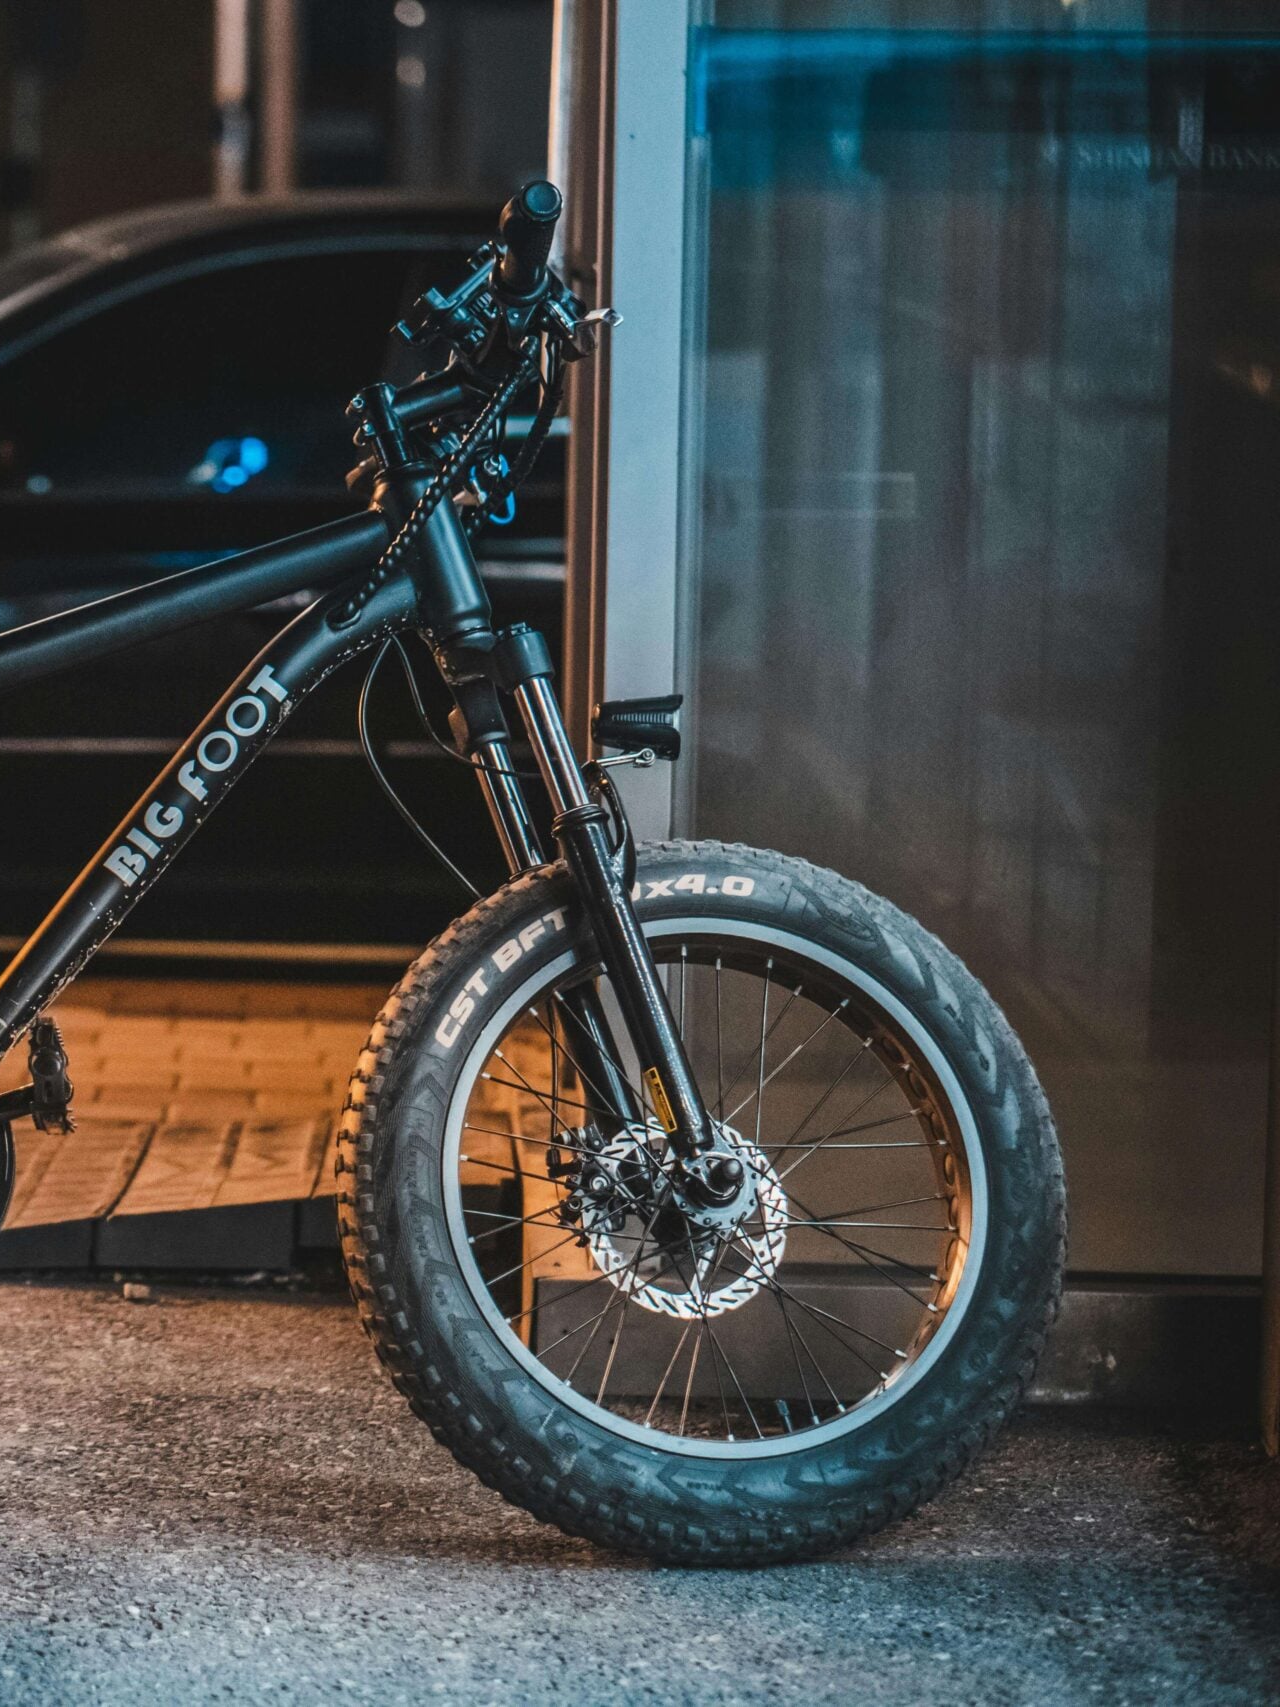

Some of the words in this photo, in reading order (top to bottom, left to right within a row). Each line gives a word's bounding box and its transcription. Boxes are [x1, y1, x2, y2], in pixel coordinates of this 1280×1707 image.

[103, 801, 184, 887] BIG
[178, 664, 288, 802] FOOT
[435, 967, 489, 1049] CST
[491, 906, 569, 973] BFT
